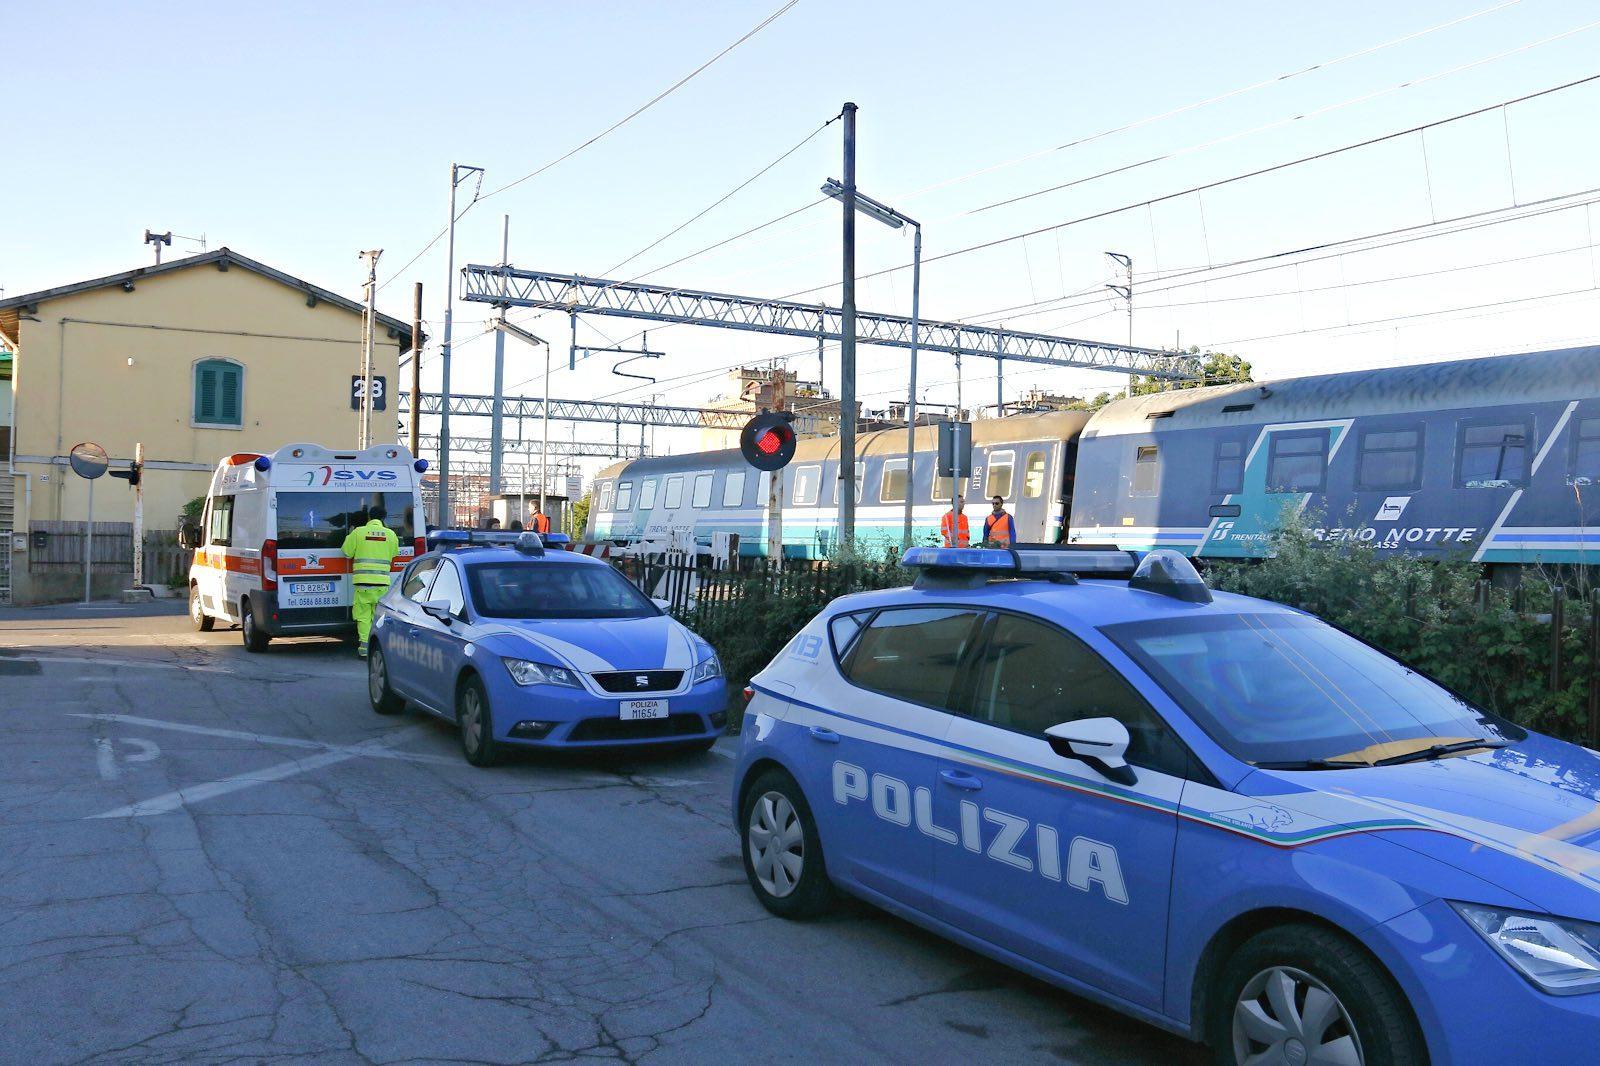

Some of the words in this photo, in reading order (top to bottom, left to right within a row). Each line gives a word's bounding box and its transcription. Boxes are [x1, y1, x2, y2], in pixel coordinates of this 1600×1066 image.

[353, 379, 383, 398] 28
[333, 470, 397, 480] SVS
[1384, 527, 1477, 542] NOTTE
[388, 631, 444, 673] POLIZIA
[630, 701, 658, 709] POLIZIA
[632, 709, 657, 719] M1654
[832, 759, 1130, 906] POLIZIA
